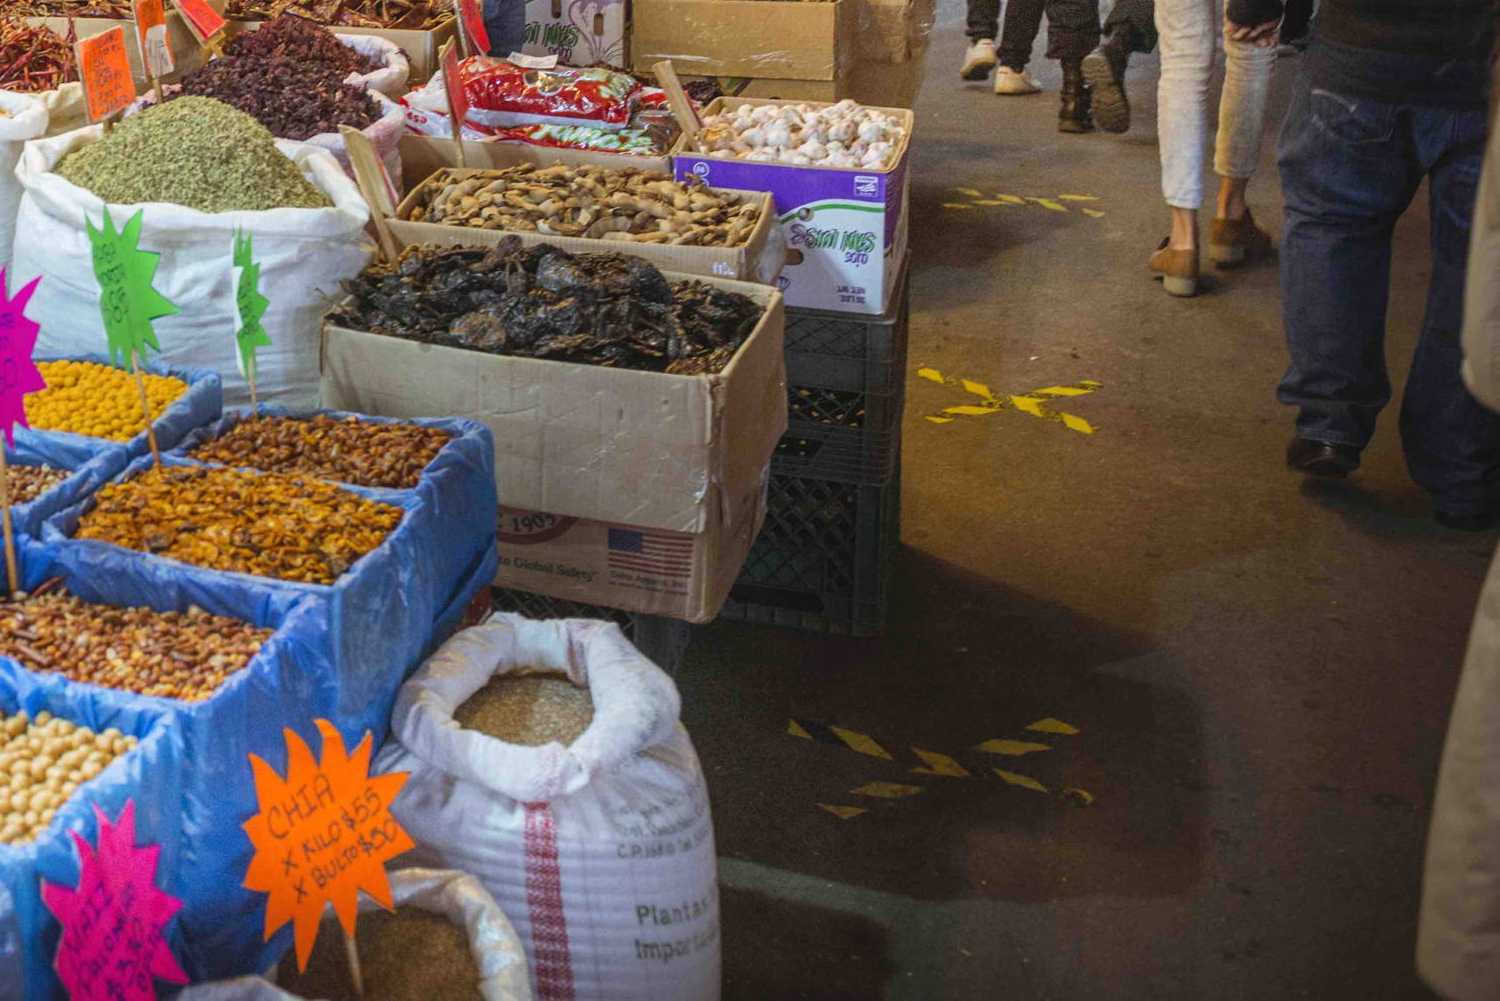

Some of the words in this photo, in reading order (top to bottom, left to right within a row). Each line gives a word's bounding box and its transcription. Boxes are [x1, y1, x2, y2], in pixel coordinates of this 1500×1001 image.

[267, 773, 336, 840] CHIA
[301, 821, 342, 862] KILO
[341, 786, 383, 831] $55
[310, 845, 360, 889] BULTO
